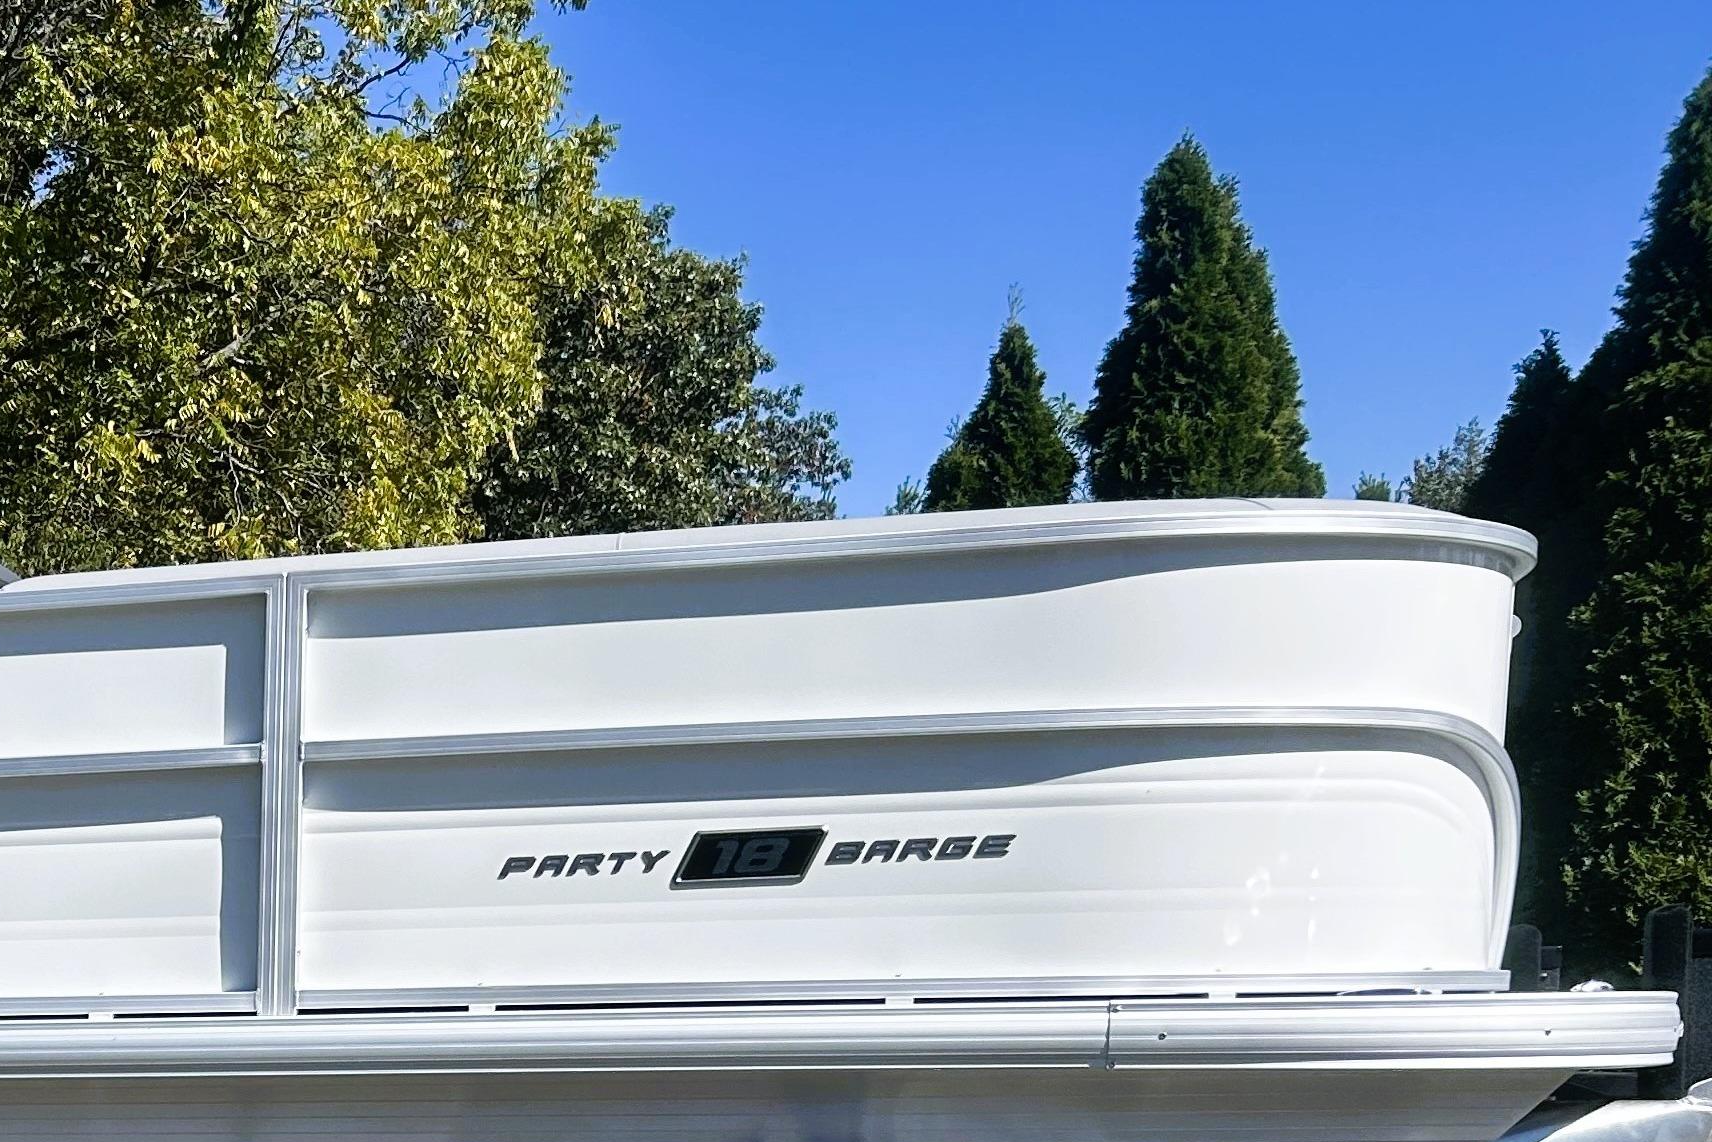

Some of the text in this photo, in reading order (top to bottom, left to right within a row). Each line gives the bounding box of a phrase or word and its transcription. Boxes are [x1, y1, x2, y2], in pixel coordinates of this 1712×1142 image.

[497, 834, 1017, 880] PARTY 18 BARGE
